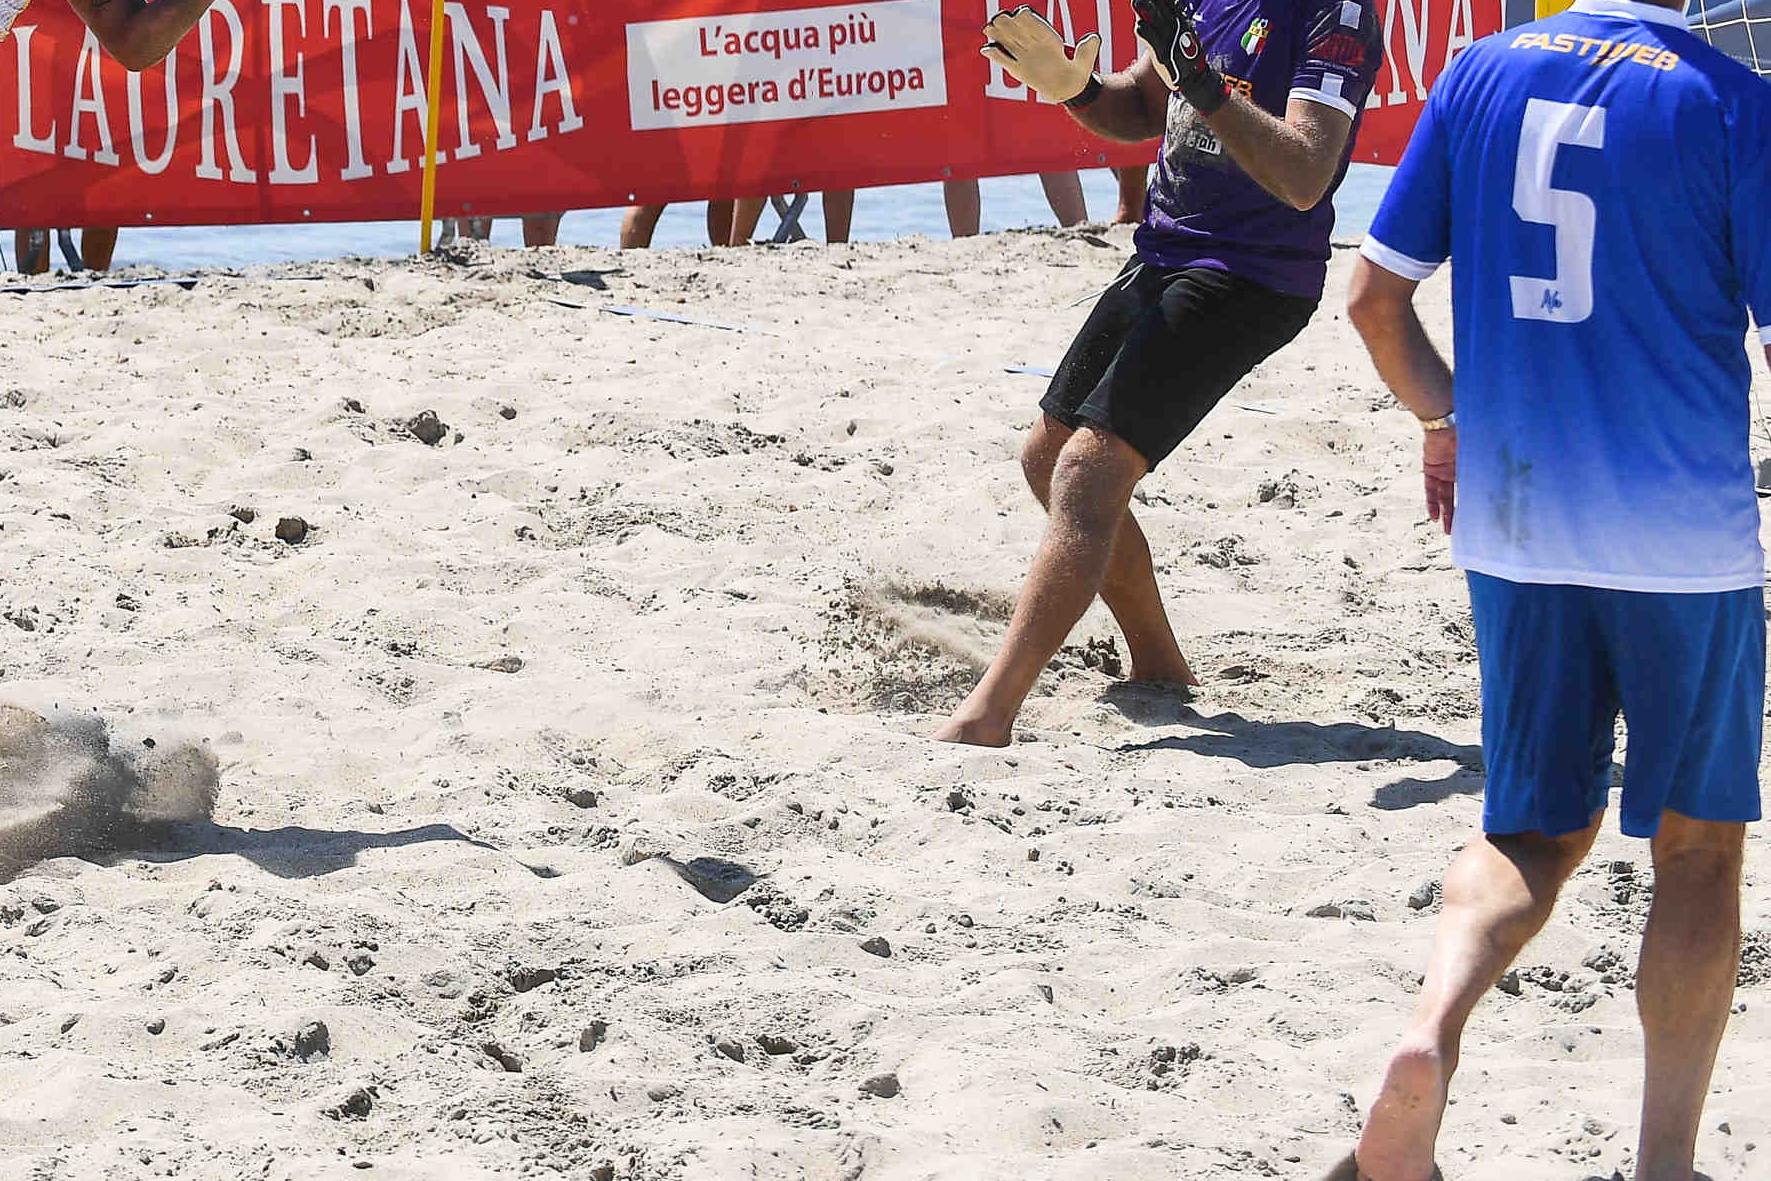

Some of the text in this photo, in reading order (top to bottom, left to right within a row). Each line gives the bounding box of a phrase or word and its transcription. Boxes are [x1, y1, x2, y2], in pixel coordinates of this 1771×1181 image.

[699, 12, 877, 60] L’acqua più
[651, 66, 926, 118] leggera d’Europa
[1509, 97, 1607, 324] 5
